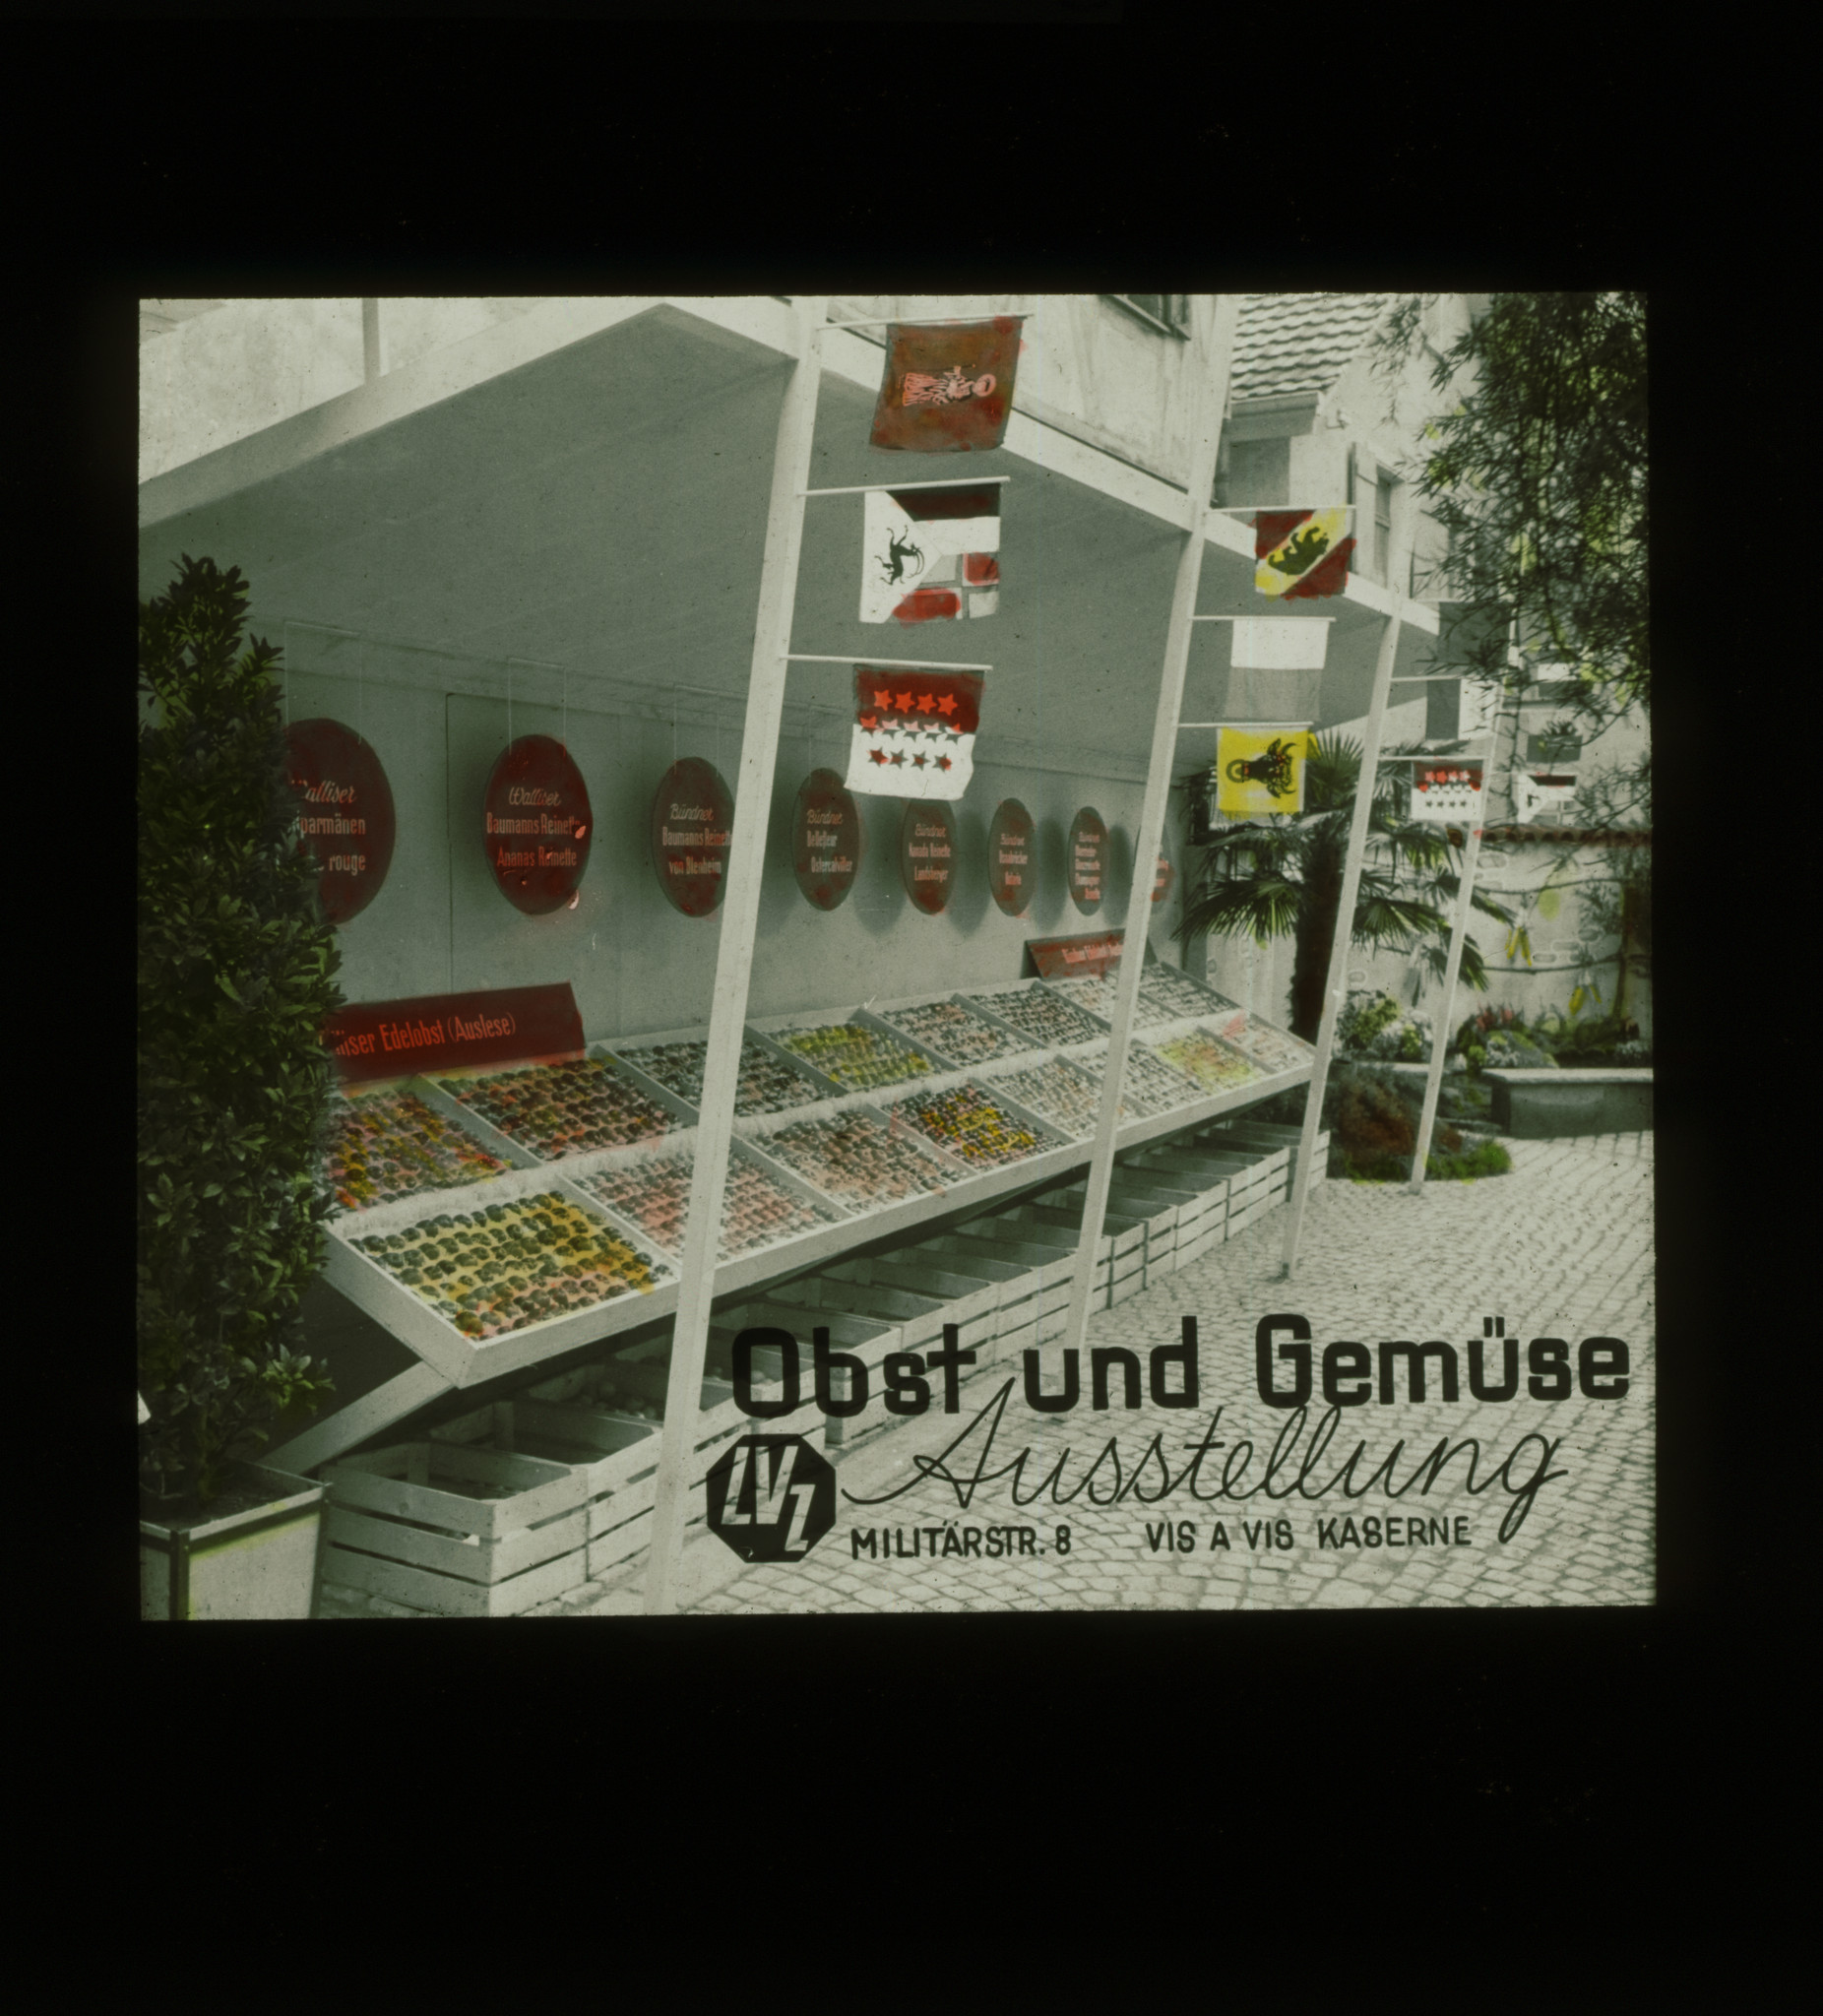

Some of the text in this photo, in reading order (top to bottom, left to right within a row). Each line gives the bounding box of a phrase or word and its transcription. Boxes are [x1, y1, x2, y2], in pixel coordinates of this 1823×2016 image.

[290, 779, 357, 804] alliser
[508, 787, 562, 807] Walliser
[486, 811, 581, 835] Baumanns Reinett
[669, 802, 715, 822] Bündner
[299, 812, 366, 840] parmänen
[661, 826, 704, 847] Baumanns
[328, 853, 367, 876] rouge
[496, 845, 578, 867] Ananas Reinette
[668, 860, 684, 875] von
[378, 1019, 445, 1052] Edelobst
[447, 1011, 516, 1043] (Auslese)
